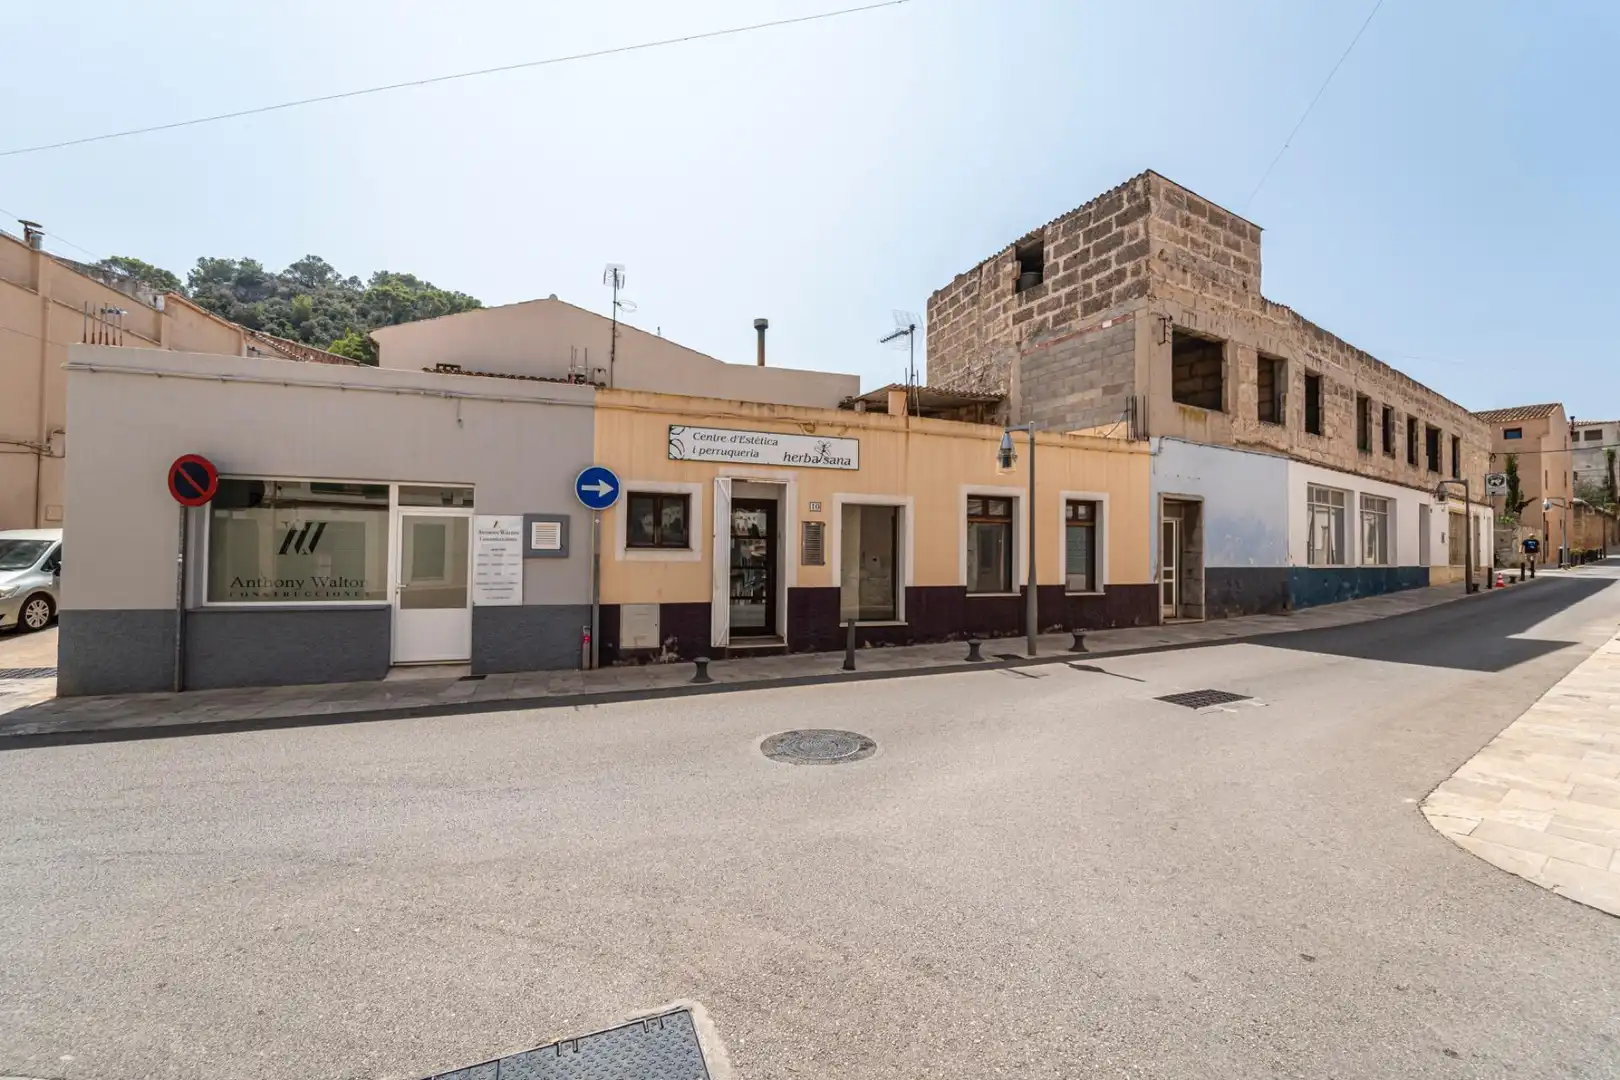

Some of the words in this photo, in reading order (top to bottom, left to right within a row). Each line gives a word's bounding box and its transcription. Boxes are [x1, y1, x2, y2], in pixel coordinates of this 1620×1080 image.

[692, 432, 727, 443] Centre
[692, 446, 696, 454] i
[782, 452, 820, 463] herba
[823, 456, 852, 466] sana
[230, 576, 305, 590] Anthony
